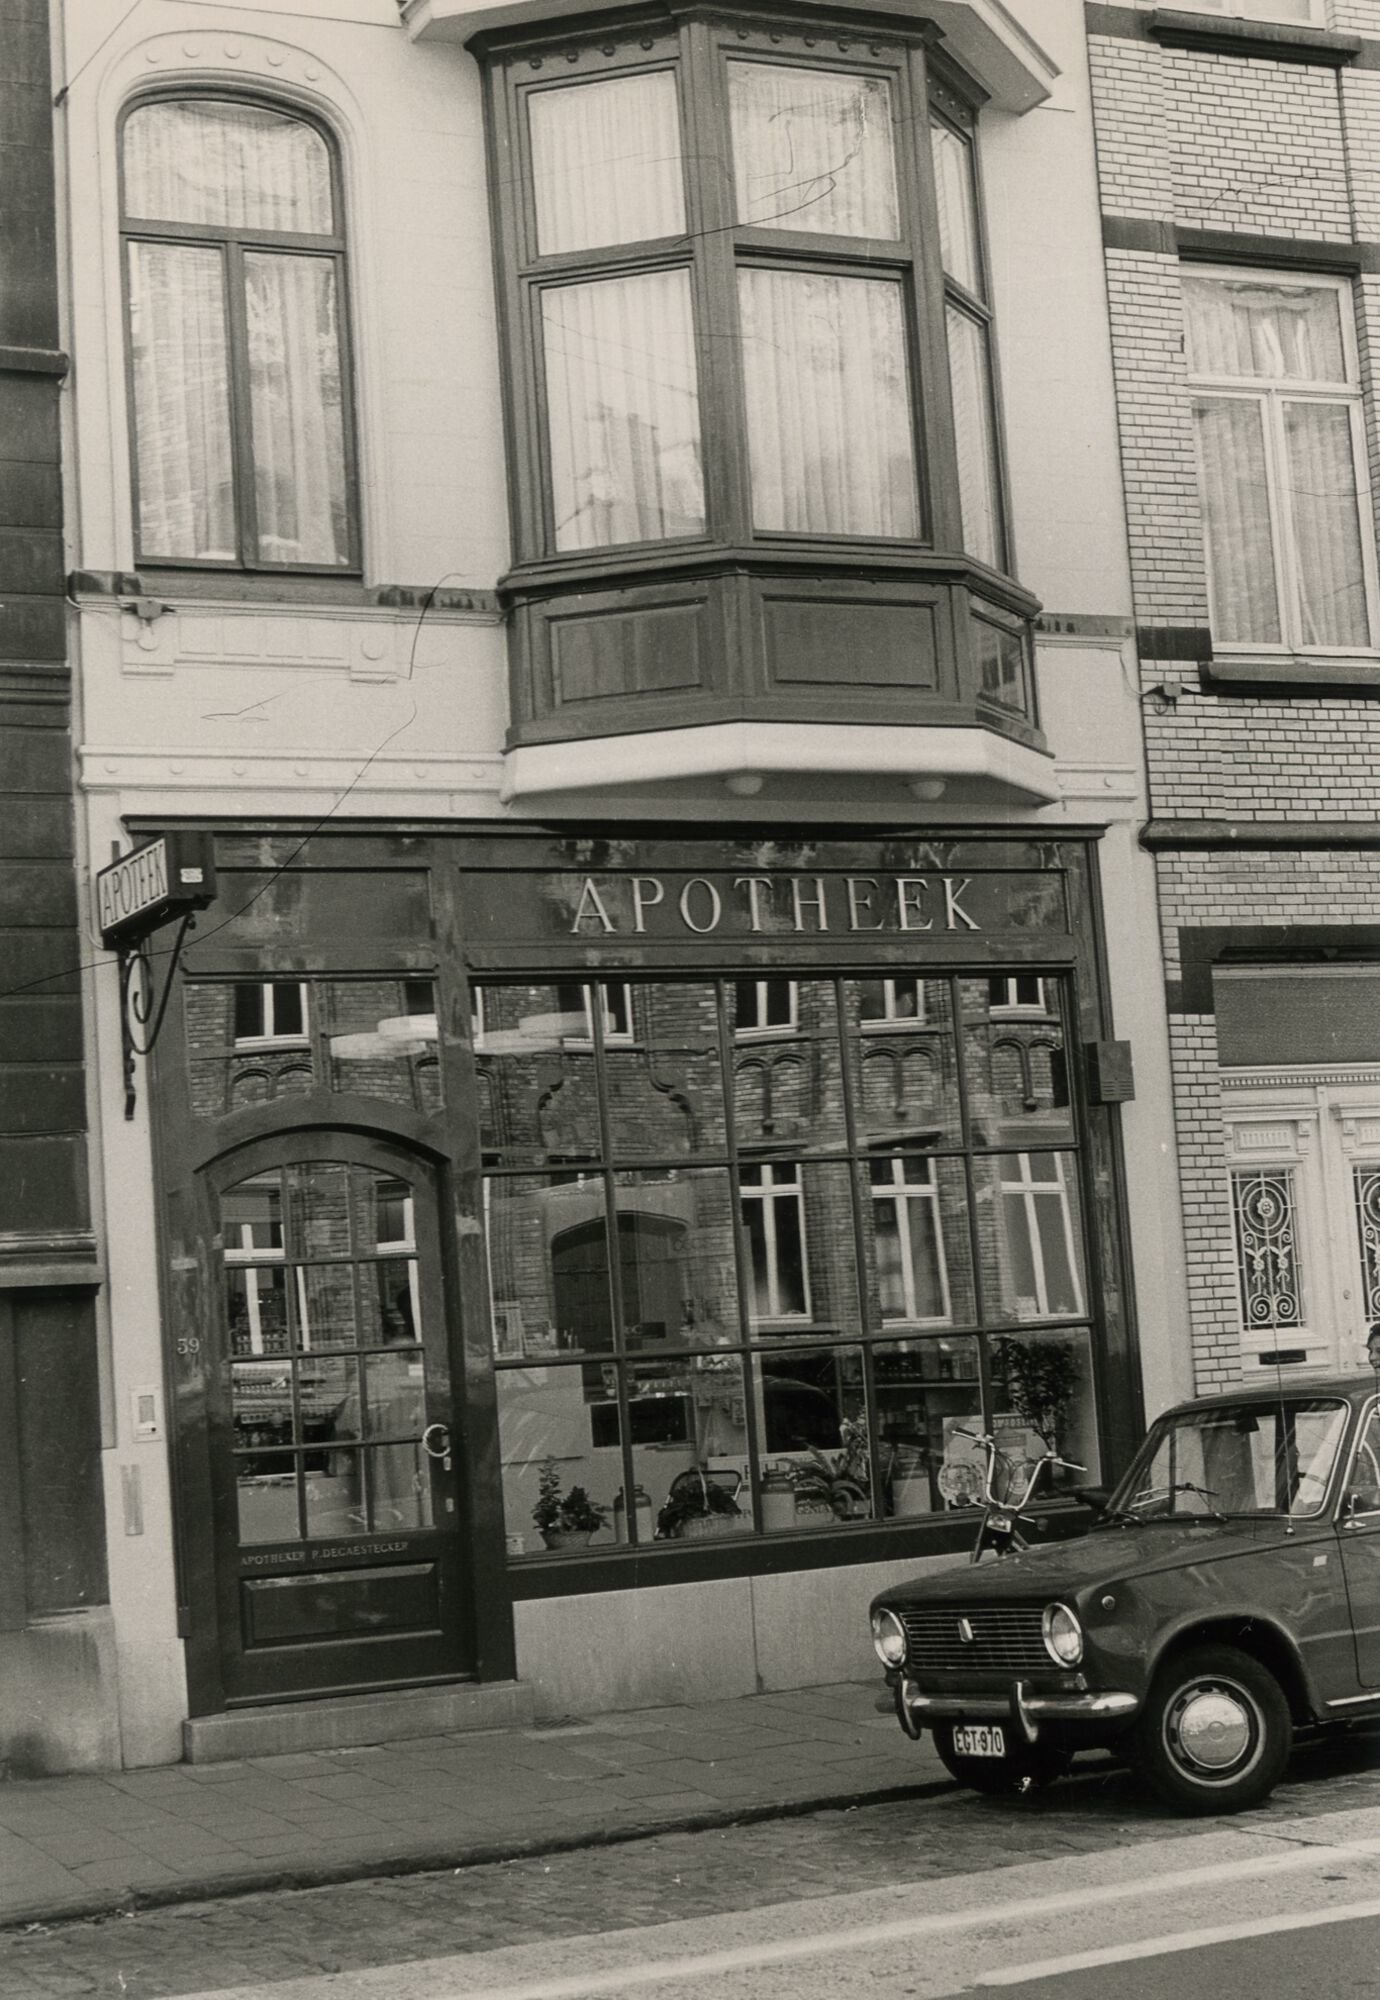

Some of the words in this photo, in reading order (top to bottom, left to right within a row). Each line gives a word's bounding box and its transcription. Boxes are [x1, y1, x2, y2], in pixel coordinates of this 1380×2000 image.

[102, 843, 166, 927] APOTEEK
[569, 877, 982, 933] APOTHEEK
[240, 1551, 306, 1566] APOTHEKER
